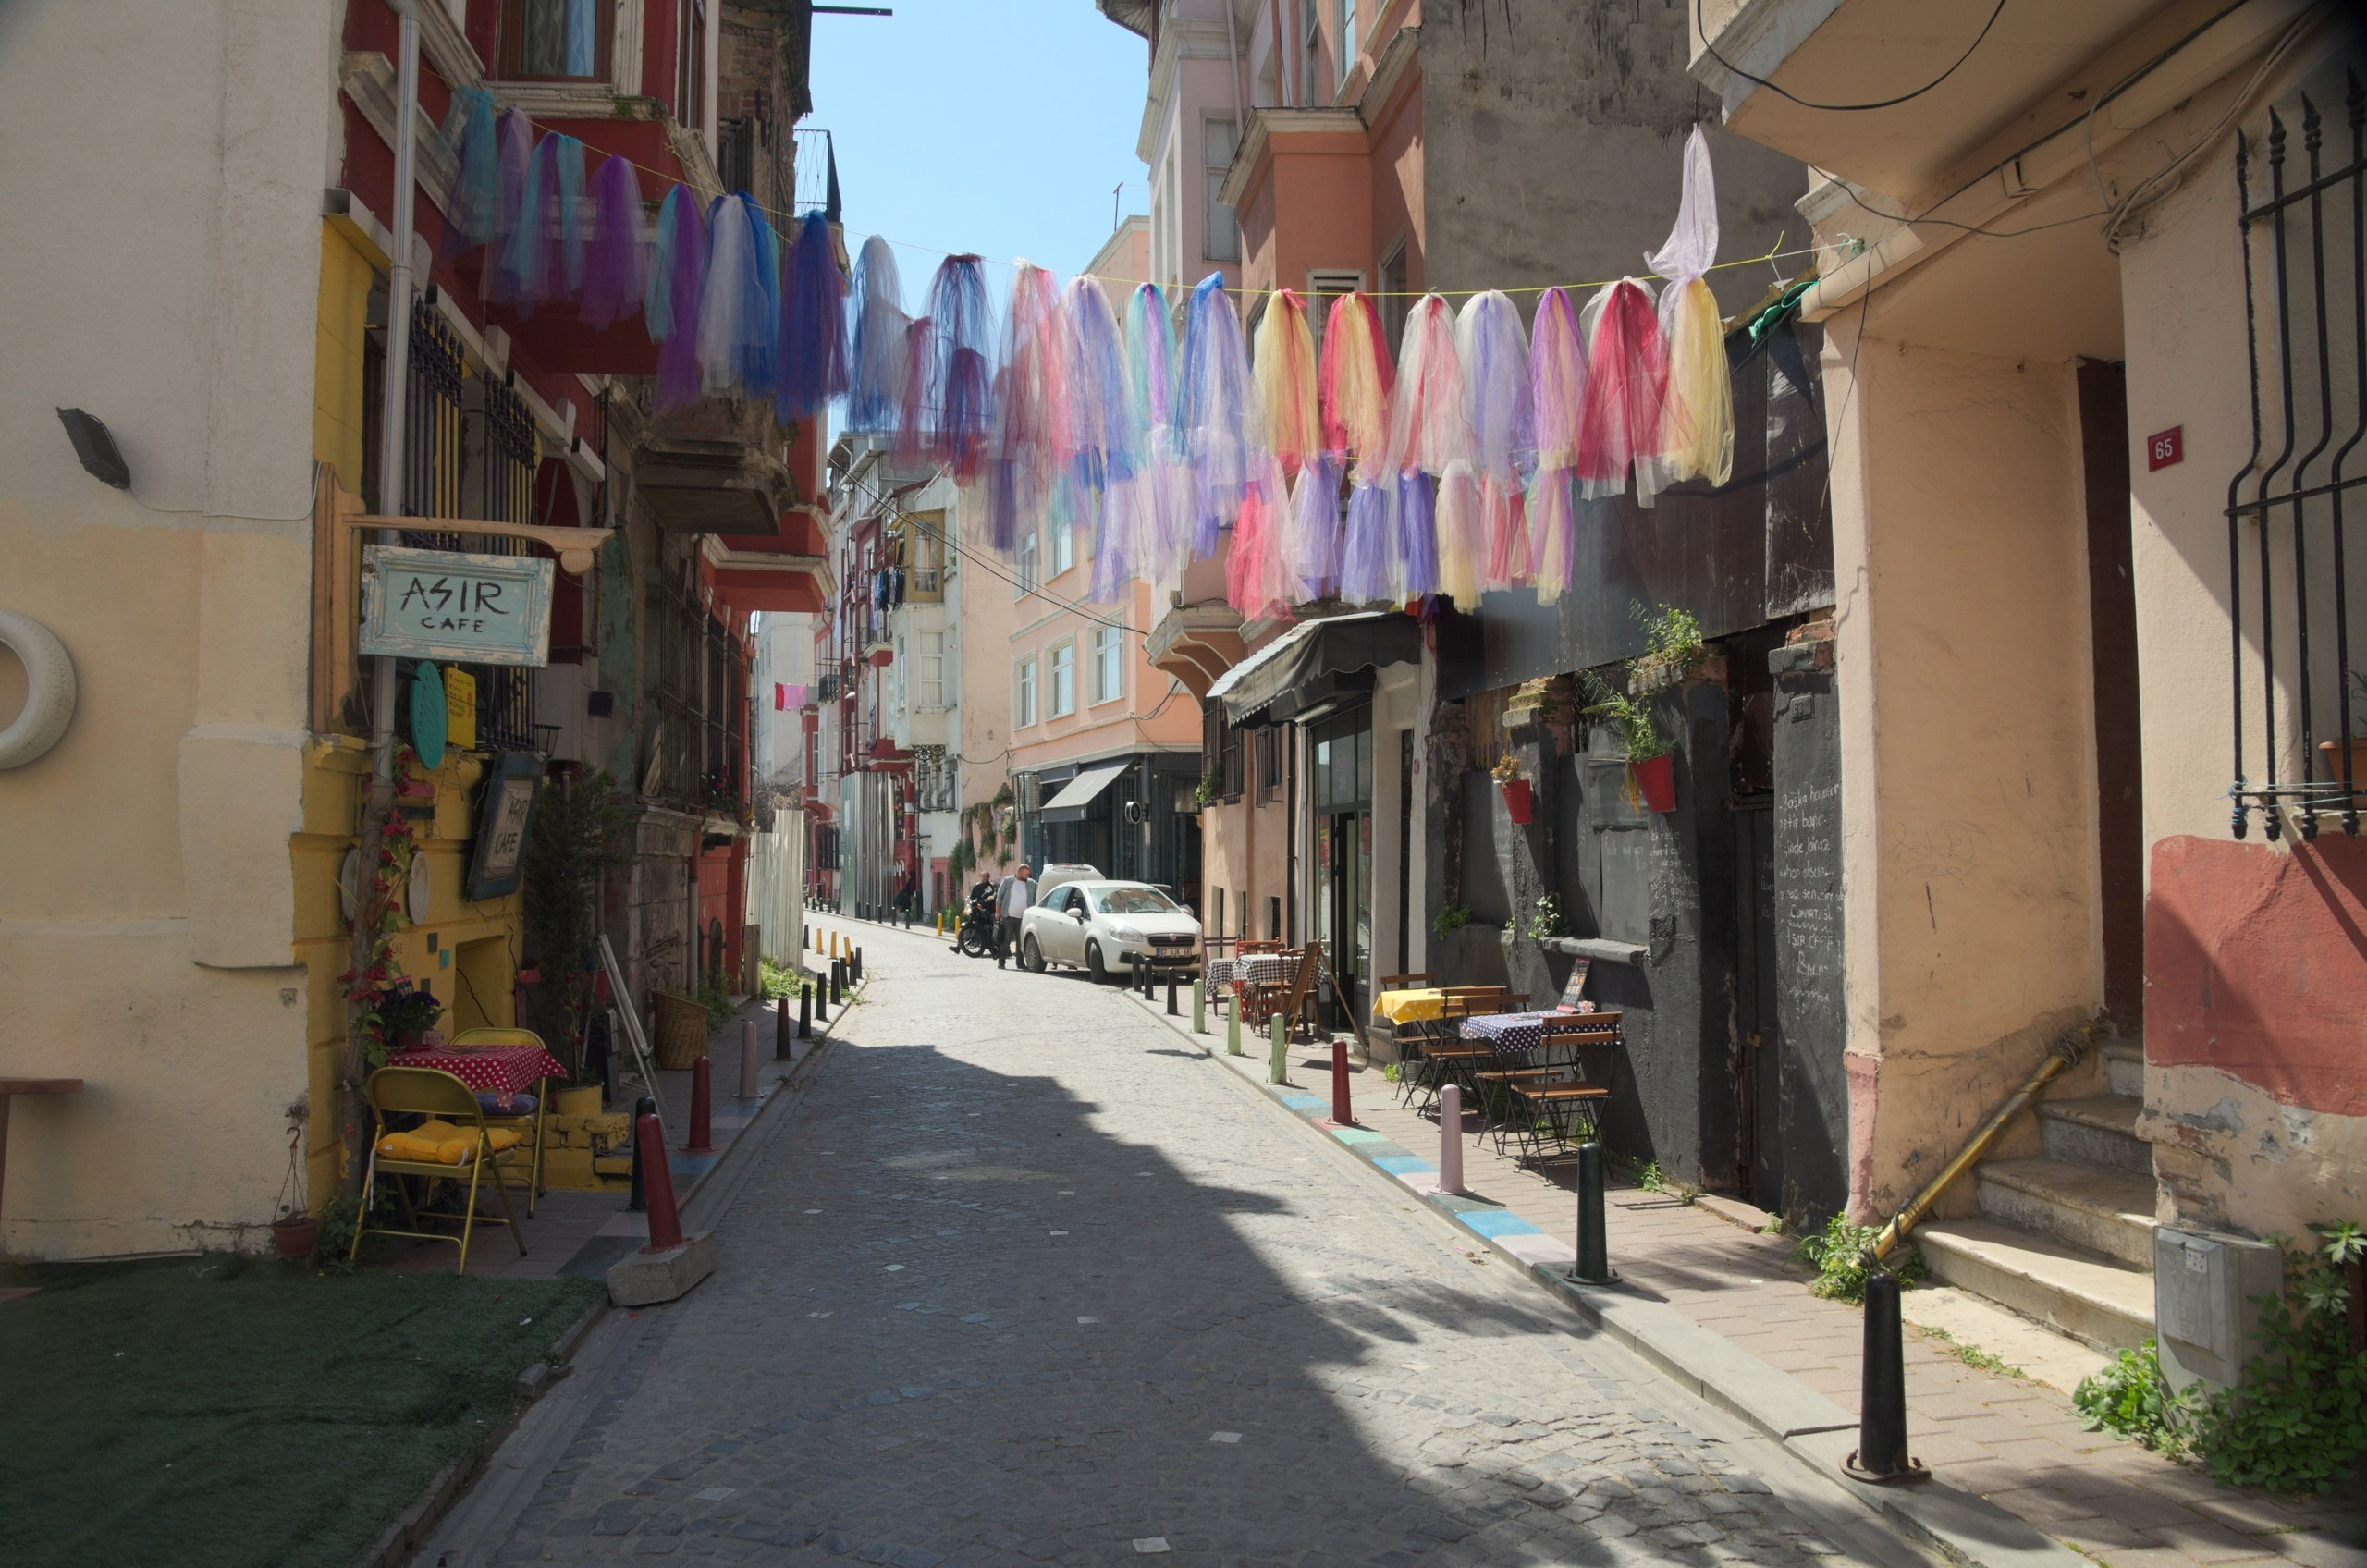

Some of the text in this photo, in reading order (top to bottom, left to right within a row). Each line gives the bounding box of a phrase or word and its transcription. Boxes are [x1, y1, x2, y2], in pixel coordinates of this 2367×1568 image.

[2155, 437, 2173, 460] 65
[399, 576, 510, 616] ASIR
[421, 616, 484, 633] CAFE
[508, 798, 528, 827] ASIR
[495, 832, 518, 855] CAFE
